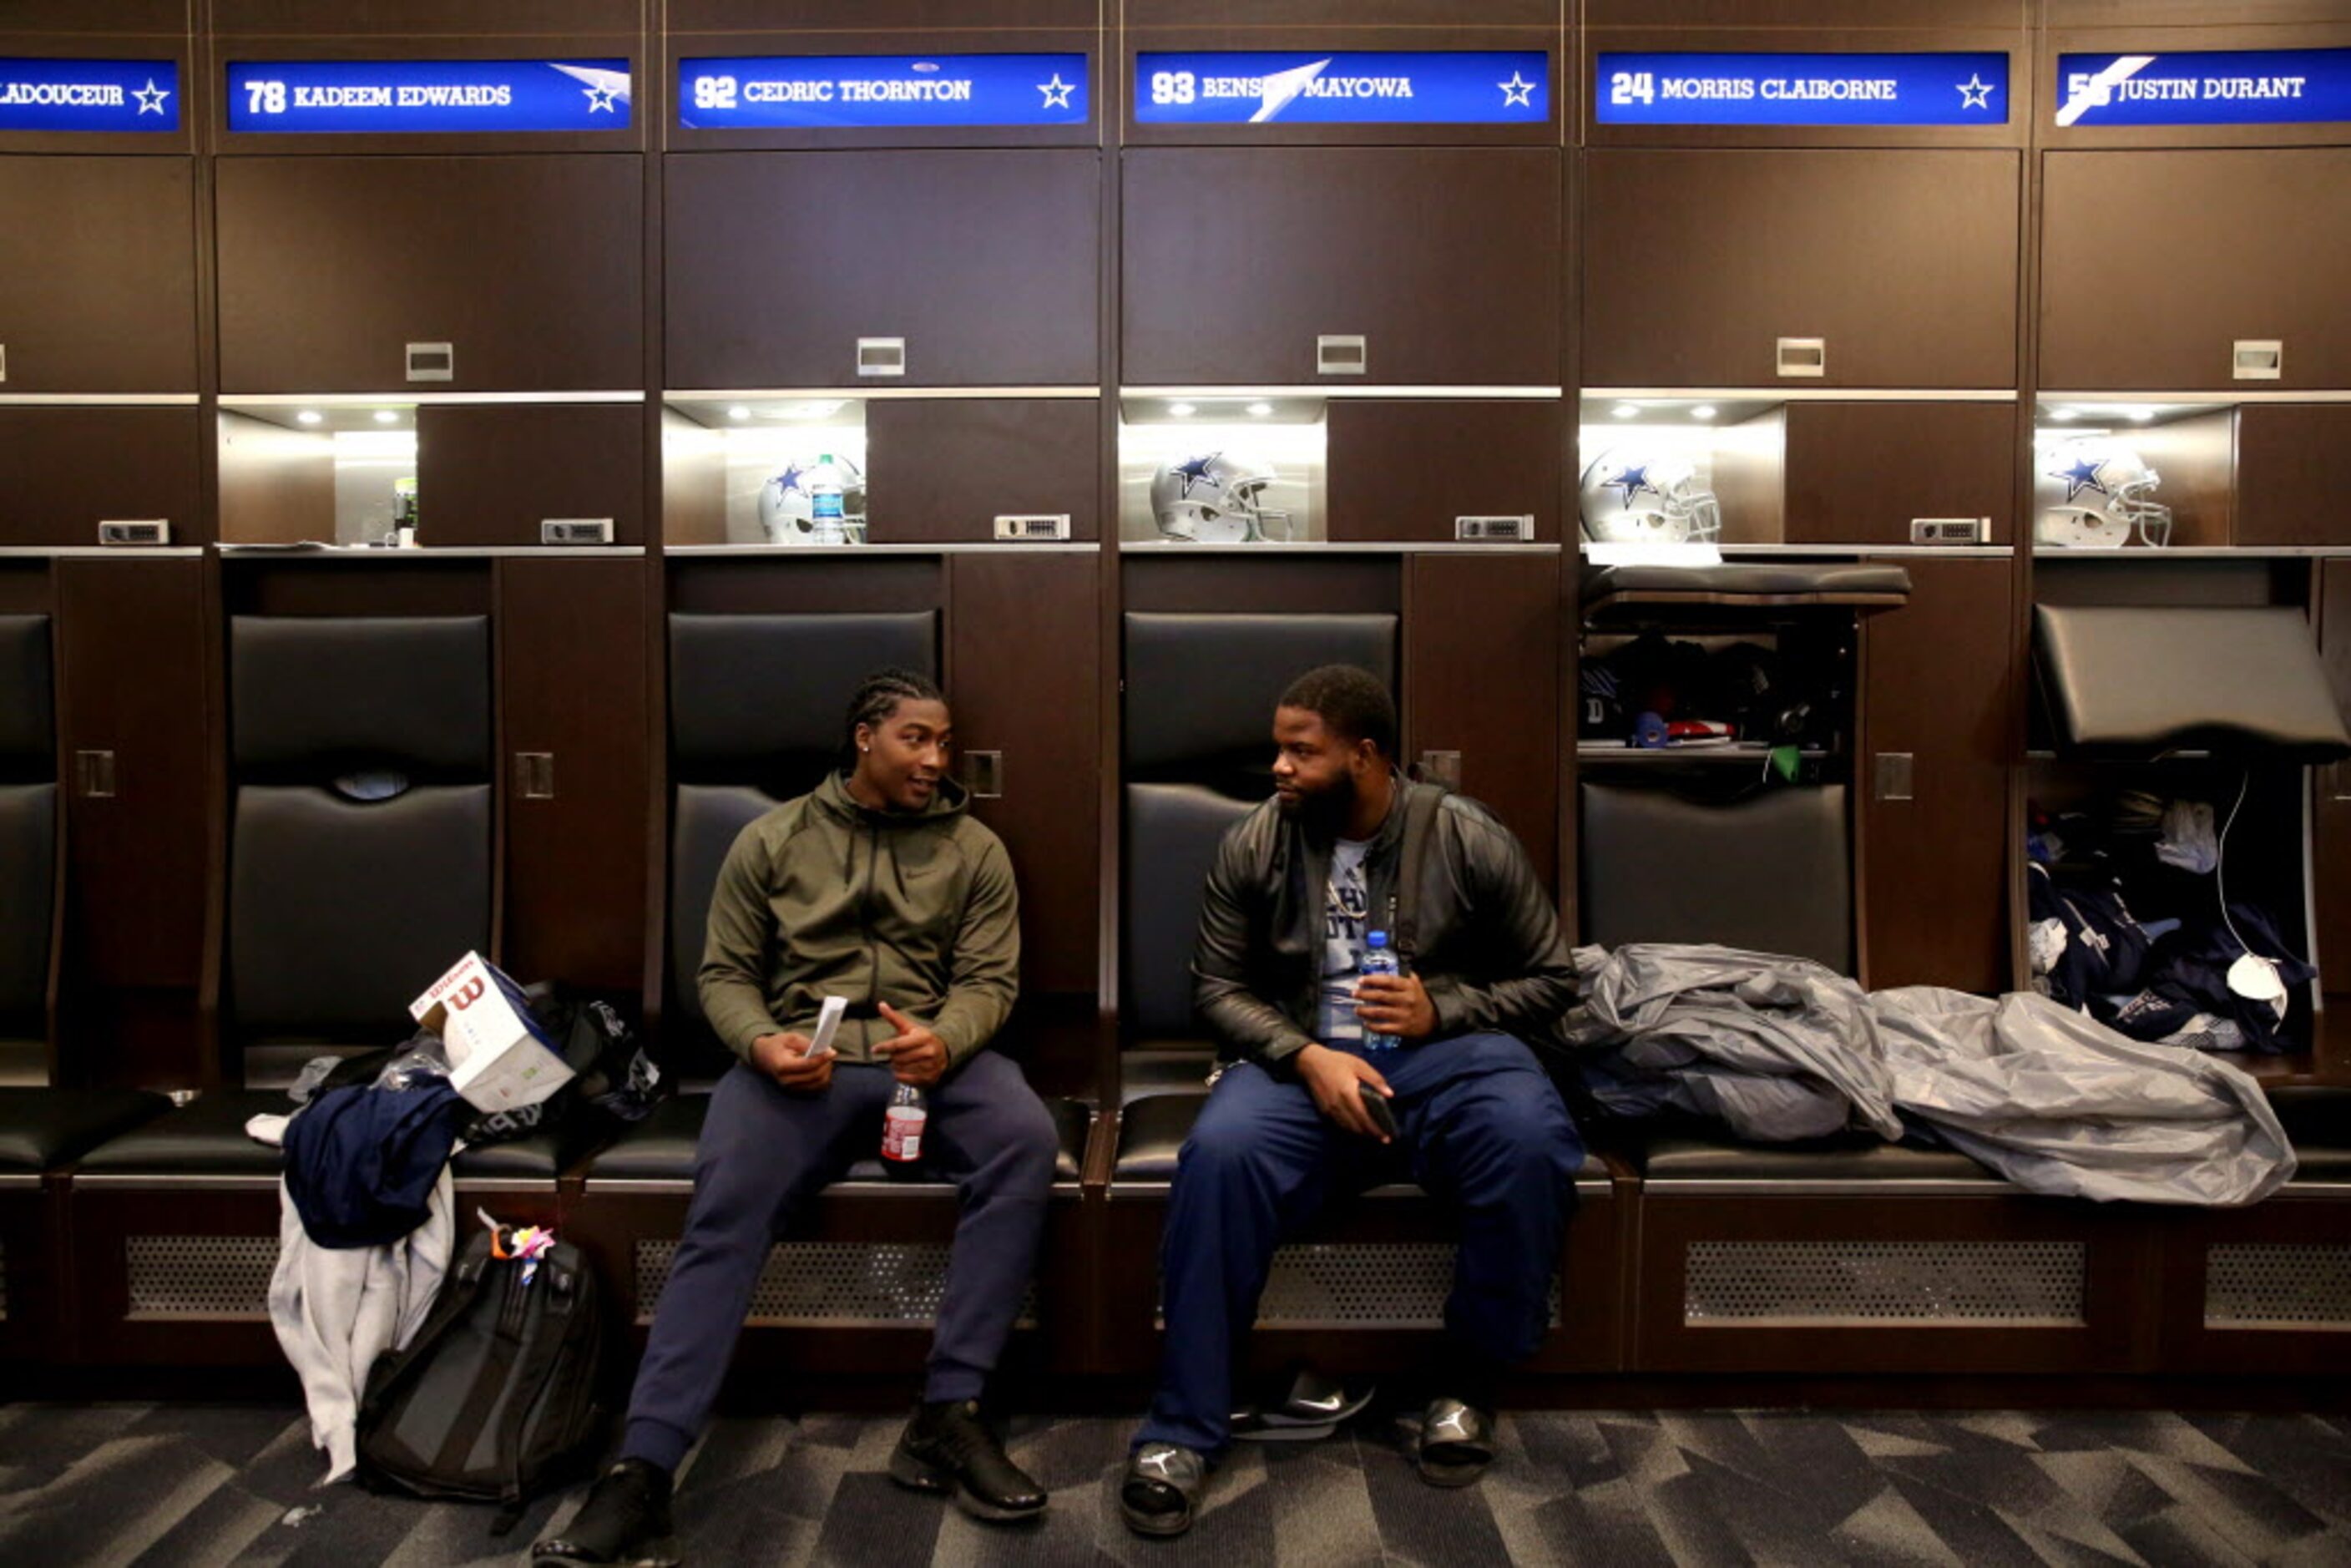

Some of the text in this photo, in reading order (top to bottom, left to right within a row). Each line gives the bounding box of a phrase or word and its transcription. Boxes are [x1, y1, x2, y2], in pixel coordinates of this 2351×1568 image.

[245, 81, 511, 113] 78 KADEEM EDWARDS
[694, 75, 971, 109] 92 CEDRIC THORNTON
[1151, 71, 1413, 104] 93 BENS MAYOWA
[1610, 72, 1897, 104] 24 MORRIS CLAIBORNE
[2118, 78, 2197, 101] JUSTIN
[2203, 76, 2305, 99] DURANT
